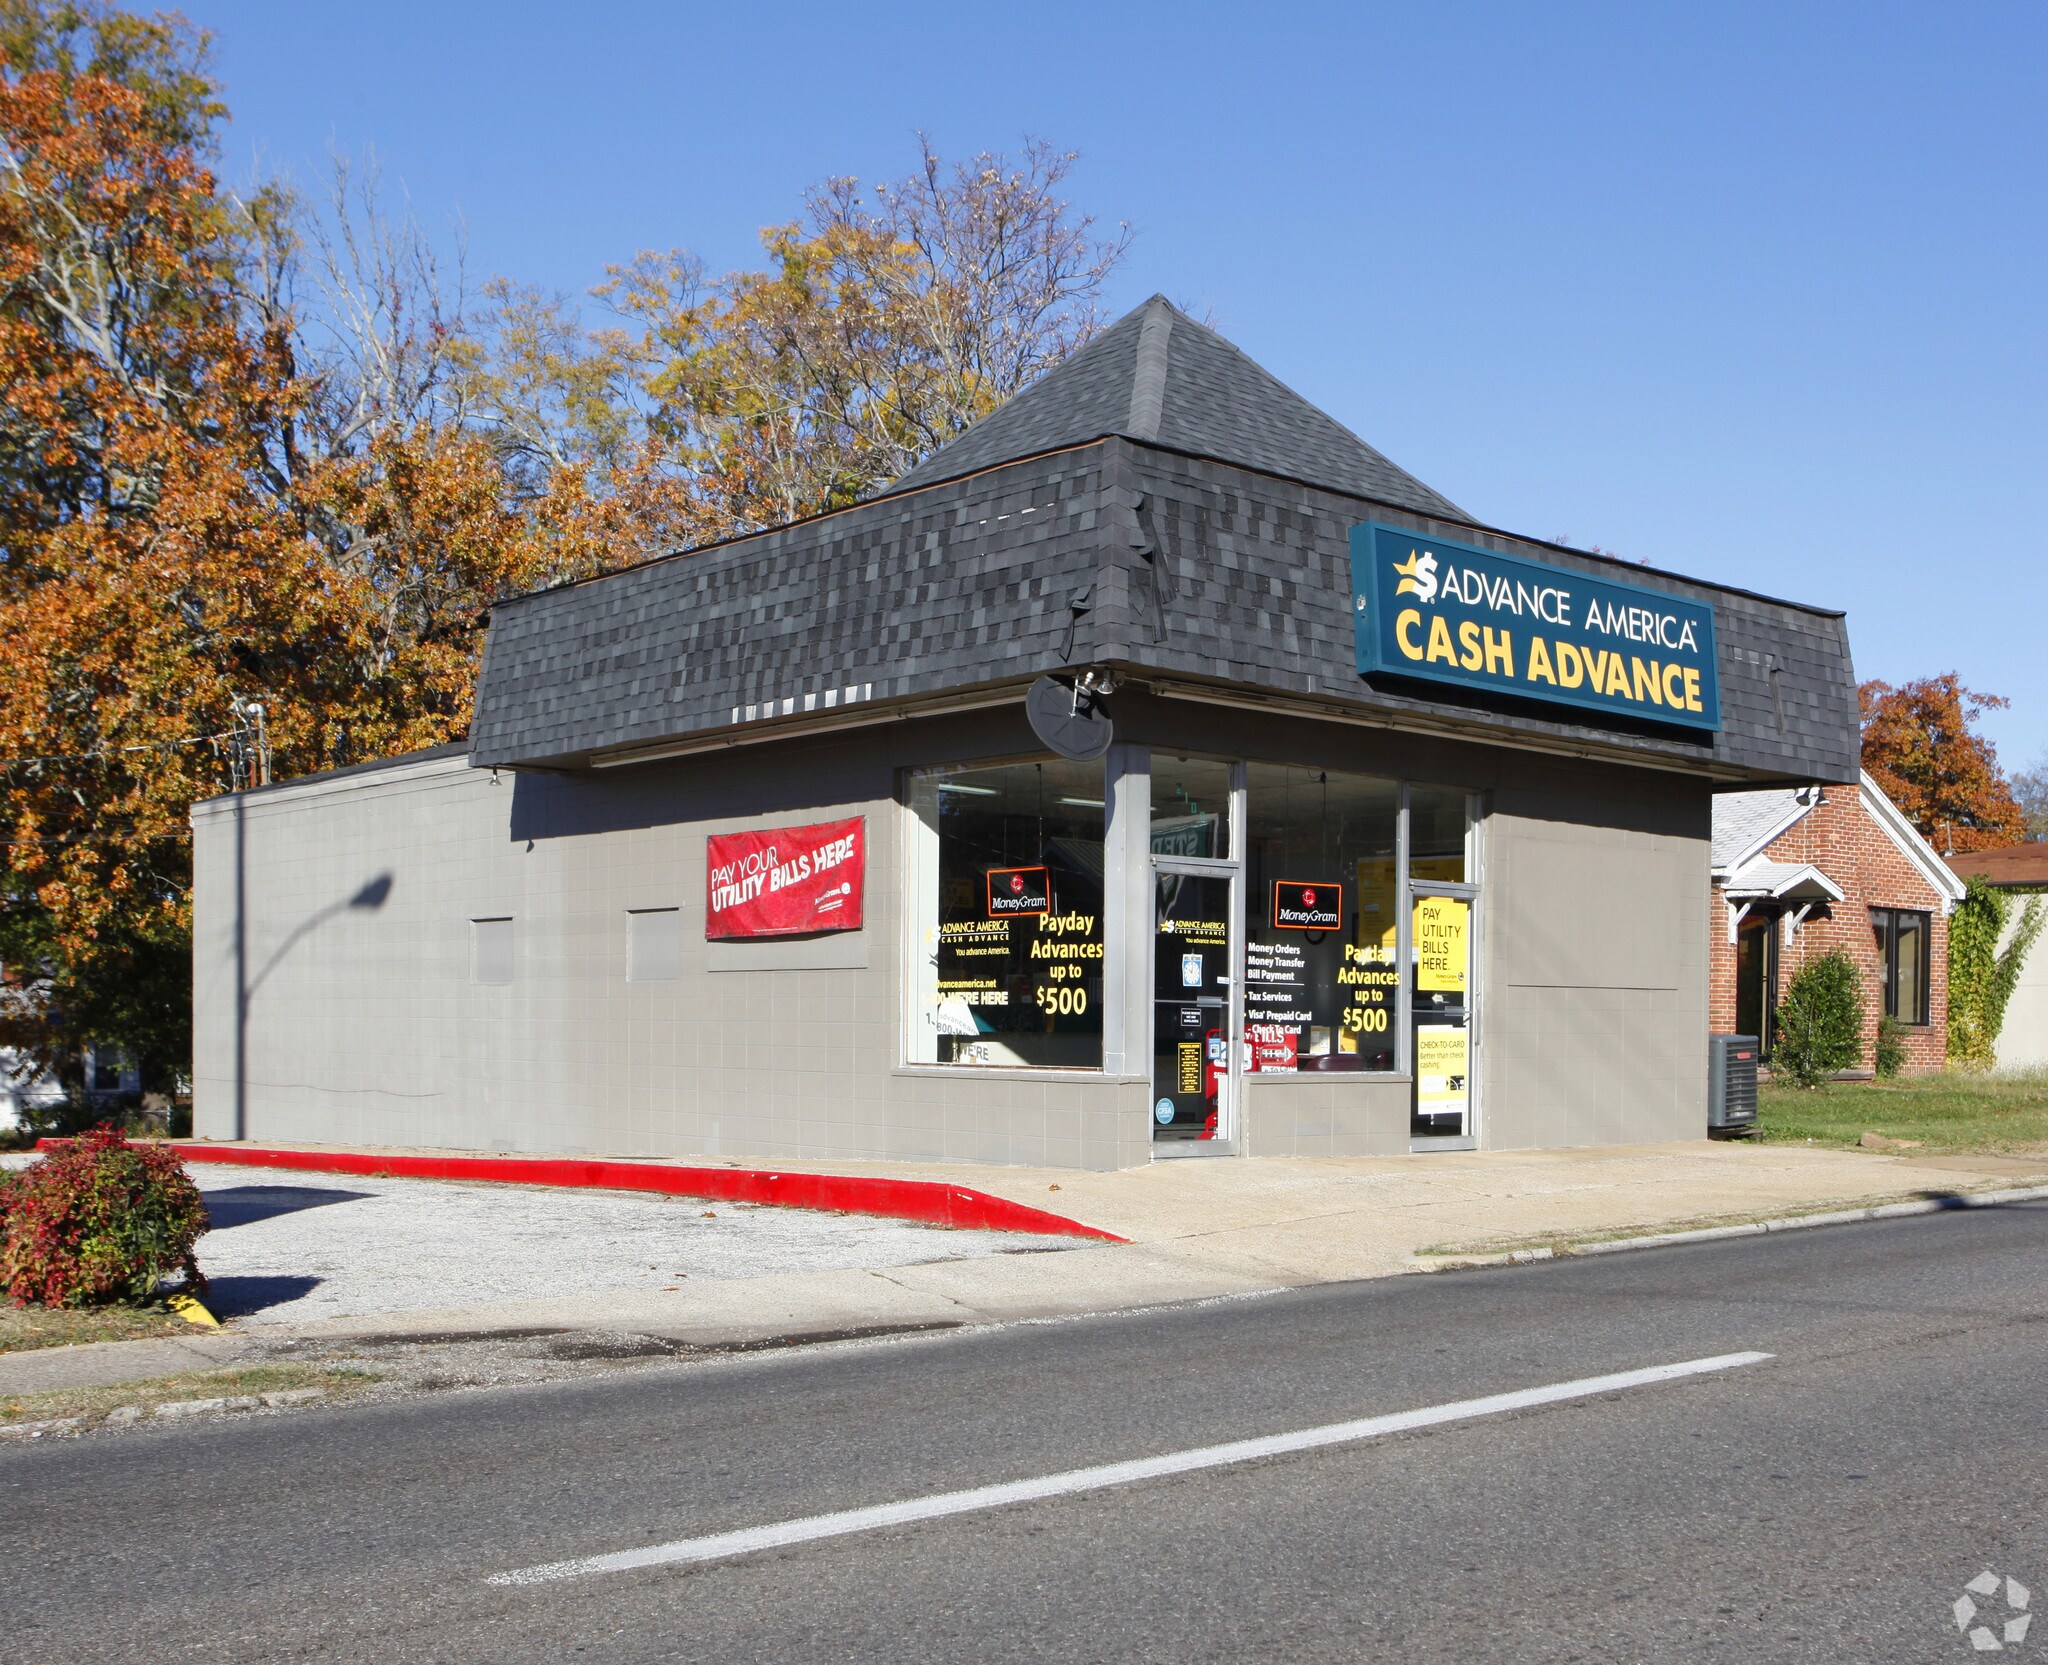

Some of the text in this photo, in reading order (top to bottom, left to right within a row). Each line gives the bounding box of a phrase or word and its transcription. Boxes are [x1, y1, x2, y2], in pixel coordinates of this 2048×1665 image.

[1441, 565, 1698, 653] ADVANCE AMERICA
[1395, 608, 1703, 712] CASH ADVANCE
[711, 846, 779, 890] PAY YOUR
[711, 833, 855, 913] UTILITY BILLS HERE
[992, 896, 1046, 910] MoneyGram
[1279, 909, 1338, 923] MoneyGram
[1422, 907, 1441, 920] PAY
[941, 920, 1009, 934] ADVANCE AMERICA
[1039, 911, 1094, 936] Payday
[1174, 920, 1200, 928] ADVANCE
[969, 934, 1009, 942] ADVANCE
[1422, 925, 1461, 938] UTILITY
[955, 948, 966, 956] You
[966, 947, 988, 956] advance
[1030, 939, 1103, 959] Advances
[1248, 942, 1300, 955] Money Orders
[1422, 941, 1449, 954] BILLS
[1248, 955, 1305, 969] Money Transfer
[1345, 944, 1392, 966] Payday
[1422, 958, 1450, 970] HERE.
[1050, 964, 1082, 982] up to
[1247, 968, 1295, 982] Bill Payment
[1337, 967, 1400, 985] Advances
[980, 991, 1009, 1005] HERE
[1036, 985, 1087, 1015] $500
[1248, 991, 1292, 1002] Tax Services
[1355, 989, 1383, 1004] up to
[1266, 1010, 1294, 1022] Prepaid
[1295, 1011, 1312, 1021] Card
[1343, 1007, 1387, 1032] $500
[1252, 1024, 1302, 1034] Check To Card
[1420, 1040, 1465, 1049] CHECK-TO-CARD
[1420, 1052, 1434, 1060] Better
